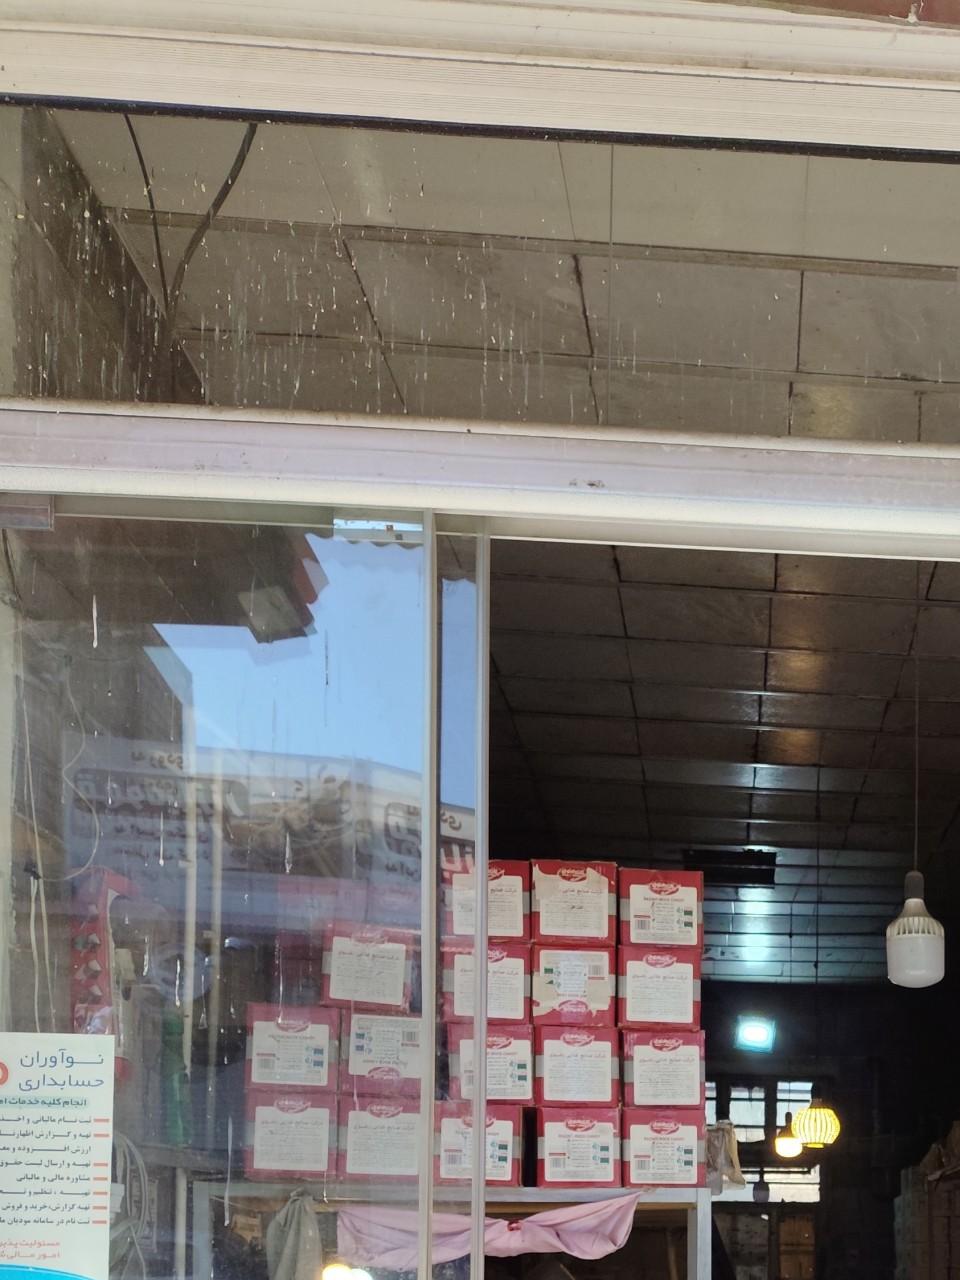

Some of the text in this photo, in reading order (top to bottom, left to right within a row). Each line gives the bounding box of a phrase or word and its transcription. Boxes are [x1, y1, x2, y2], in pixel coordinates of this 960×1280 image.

[20, 1048, 104, 1068] نوآوران
[18, 1073, 105, 1091] حسابداری
[8, 1097, 40, 1107] خدمات
[41, 1098, 63, 1107] کلیه
[62, 1098, 87, 1108] انجام
[47, 1173, 65, 1182] مالی
